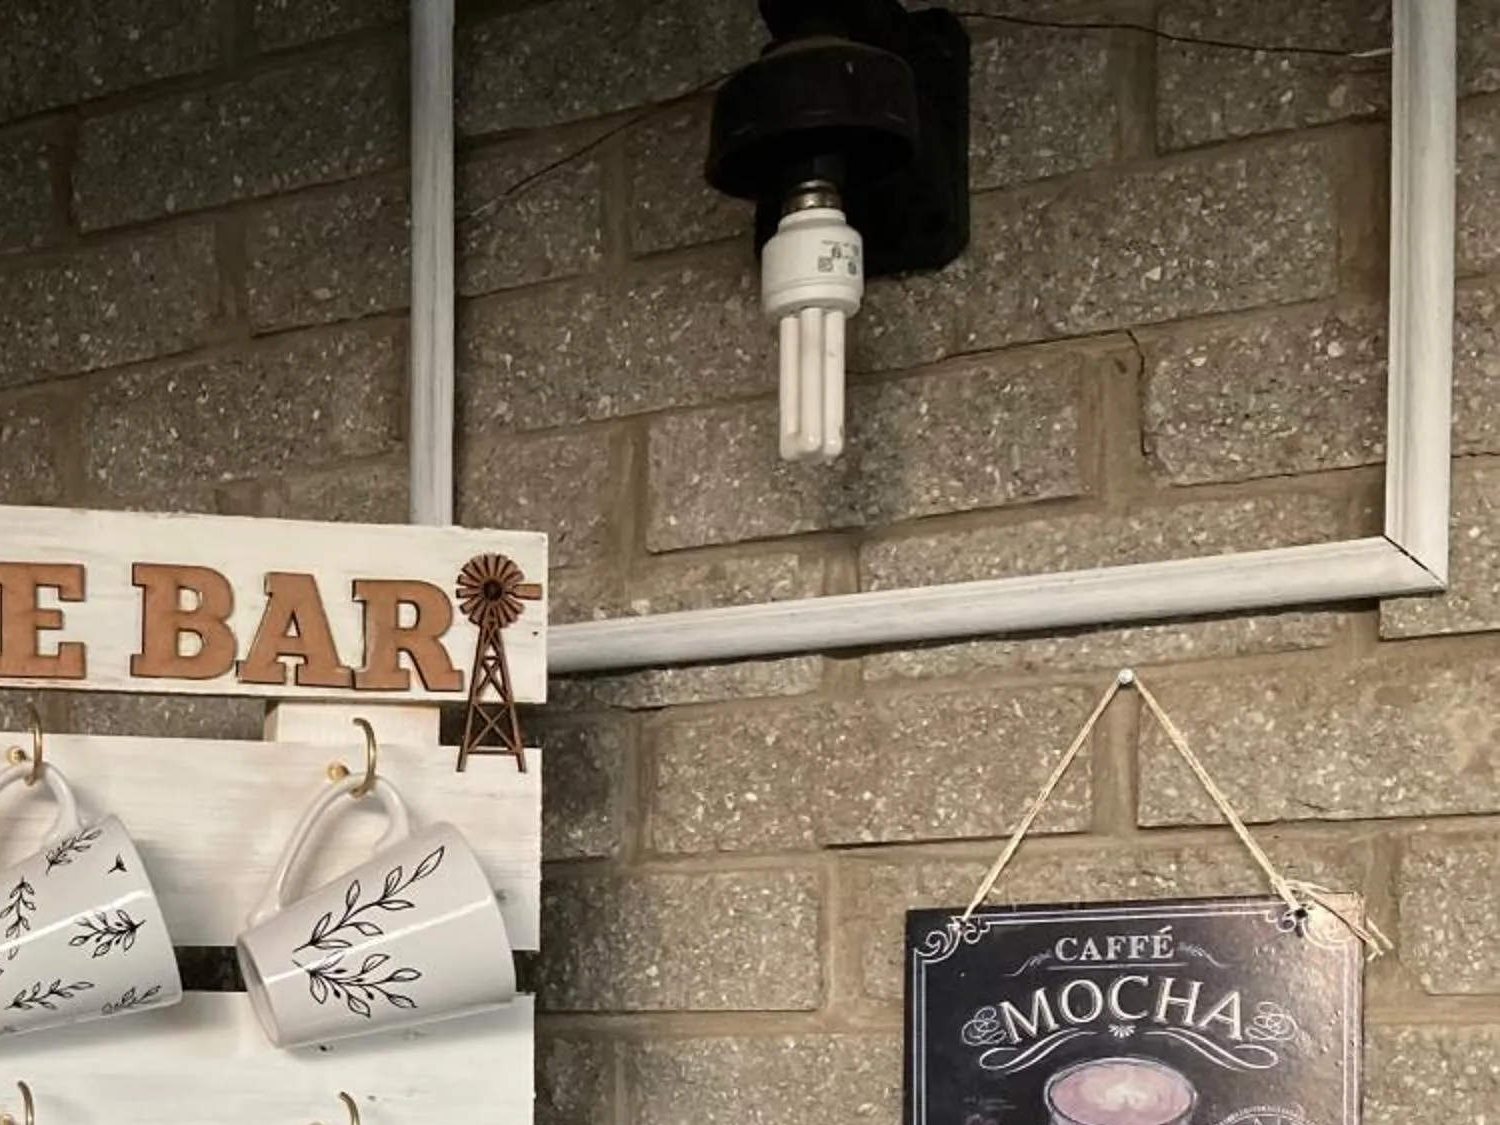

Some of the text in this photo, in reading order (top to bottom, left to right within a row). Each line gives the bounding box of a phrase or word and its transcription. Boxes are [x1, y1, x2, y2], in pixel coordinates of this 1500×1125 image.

[130, 561, 465, 692] BAR
[1054, 926, 1175, 962] CAFFÉ
[997, 975, 1245, 1046] MOCHA
